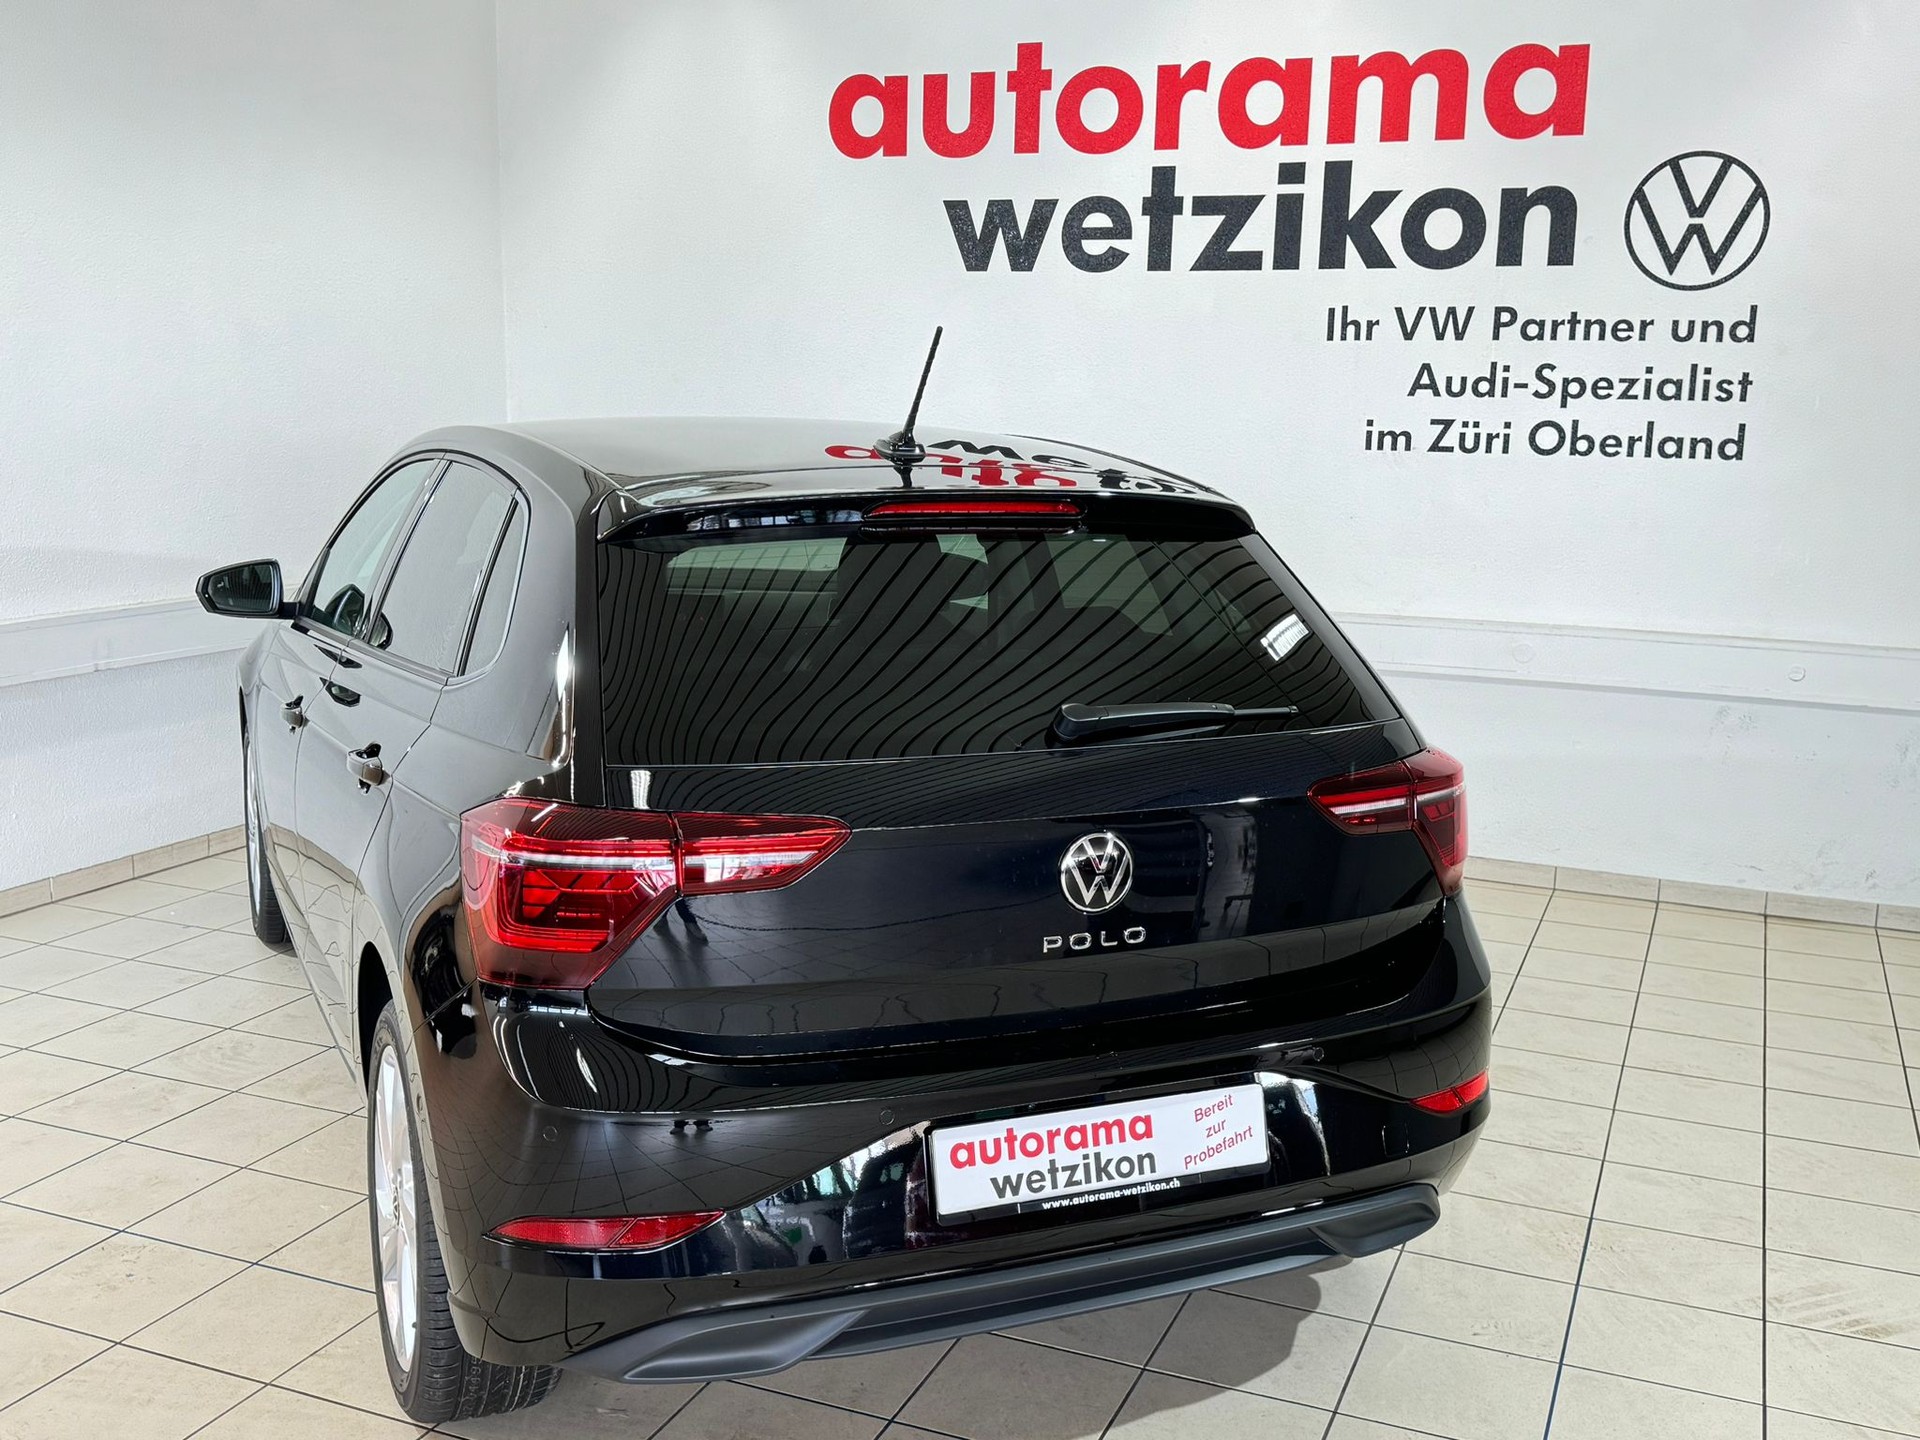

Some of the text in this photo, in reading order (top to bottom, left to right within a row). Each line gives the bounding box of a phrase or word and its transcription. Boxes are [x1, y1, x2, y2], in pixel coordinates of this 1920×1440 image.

[828, 42, 1591, 160] autorama
[942, 160, 1579, 273] wetzikon
[1326, 304, 1758, 343] Ihr VW Partner und
[1407, 361, 1753, 409] Audi-Spezialist
[1365, 418, 1747, 461] im Züri Oberland
[1042, 926, 1147, 953] POLO
[1193, 1093, 1234, 1123] Bereit
[1205, 1118, 1227, 1138] zur
[949, 1115, 1154, 1170] autorama
[1183, 1125, 1254, 1170] Probefahrt
[989, 1150, 1157, 1199] wetzikon
[1041, 1177, 1181, 1211] www.autorama-wetzikon.ch
